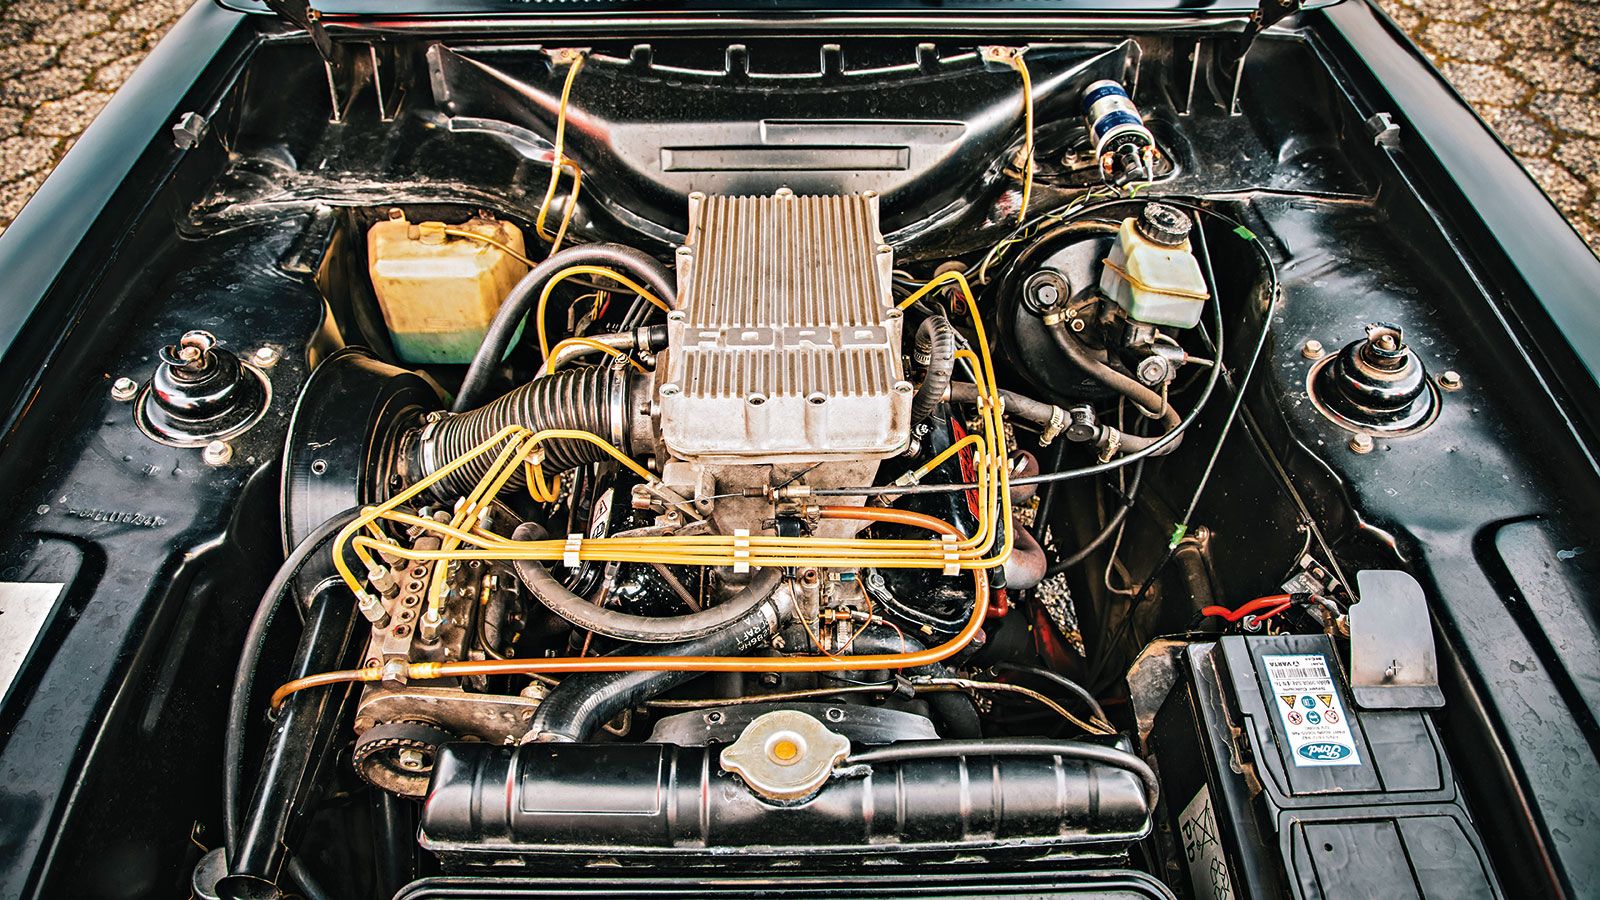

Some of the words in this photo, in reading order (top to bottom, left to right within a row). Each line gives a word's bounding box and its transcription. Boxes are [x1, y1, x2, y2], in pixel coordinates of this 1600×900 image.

[683, 325, 889, 346] FORD
[1307, 744, 1342, 759] Ford
[1182, 820, 1195, 863] Pb
